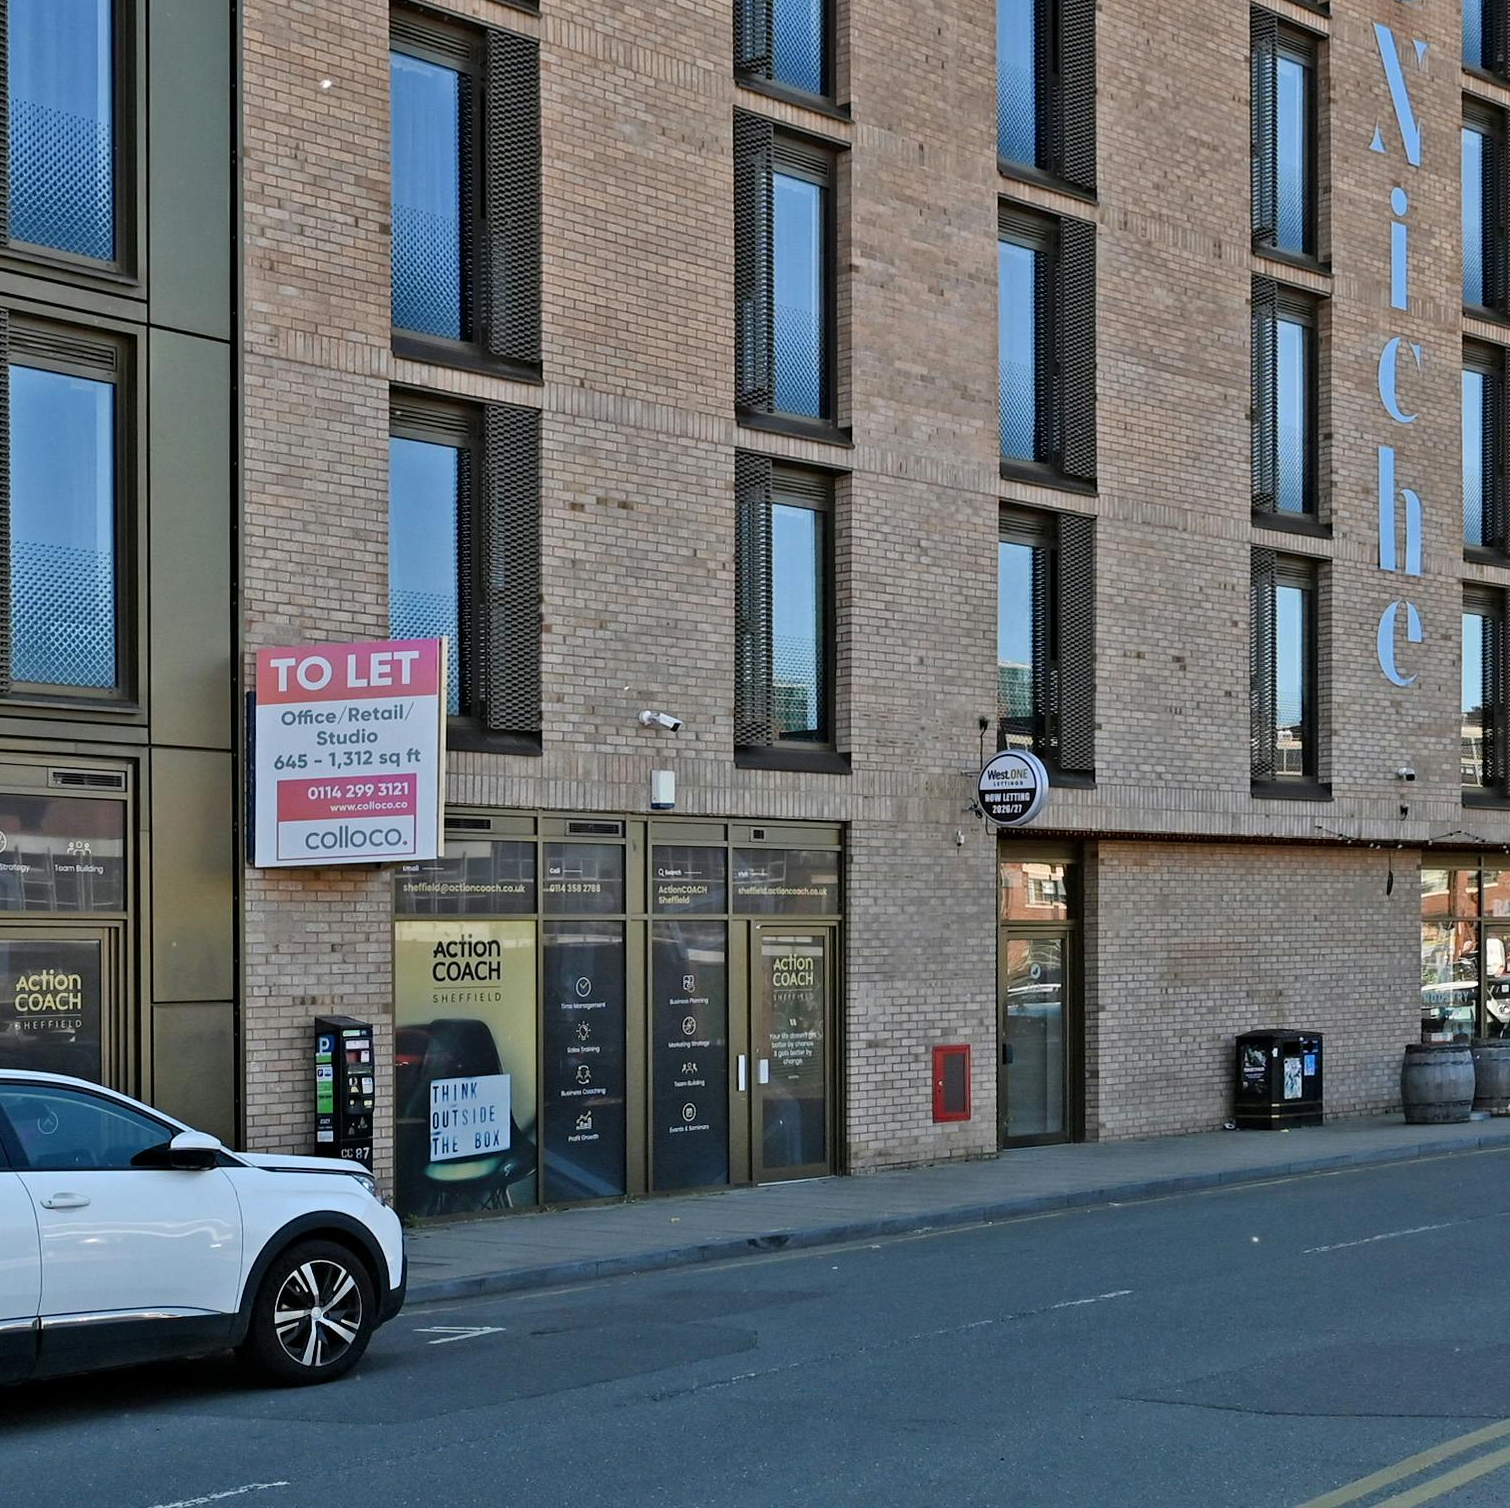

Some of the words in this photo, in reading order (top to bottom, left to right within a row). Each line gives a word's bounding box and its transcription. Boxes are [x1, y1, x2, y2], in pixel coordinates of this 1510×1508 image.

[1368, 22, 1429, 687] Niche
[270, 655, 333, 692] TO
[347, 650, 420, 688] LET
[281, 701, 415, 726] Office/Retail/
[316, 729, 378, 746] Studio
[274, 753, 308, 770] 645
[328, 750, 373, 769] 1,312
[379, 751, 400, 768] sq
[406, 748, 421, 763] ft
[307, 785, 342, 800] 0114
[346, 783, 374, 797] 299
[378, 782, 409, 796] 3121
[1002, 792, 1031, 802] LETTING
[330, 800, 408, 813] www.colloco.co
[992, 804, 1022, 814] 2026/27
[305, 826, 408, 850] colloco.
[54, 863, 75, 873] Team
[75, 864, 104, 875] Building
[402, 882, 526, 894] sheffield@actioncoach.co.uk
[549, 883, 566, 893] 0114
[658, 885, 708, 895] ActionCOACH
[658, 895, 691, 905] Sheffield
[433, 934, 501, 958] Action
[773, 954, 814, 971] Action
[432, 961, 501, 982] COACH
[772, 972, 814, 987] COACH
[15, 969, 82, 992] Action
[14, 993, 82, 1012] COACH
[433, 992, 502, 1004] SHEFFIELD
[14, 1019, 83, 1031] SHEFFIELD
[319, 1036, 330, 1053] P
[433, 1081, 478, 1104] THINK
[432, 1105, 496, 1130] OUTSIDE
[433, 1135, 459, 1156] THE
[474, 1130, 501, 1150] BOX
[355, 1147, 370, 1160] 87
